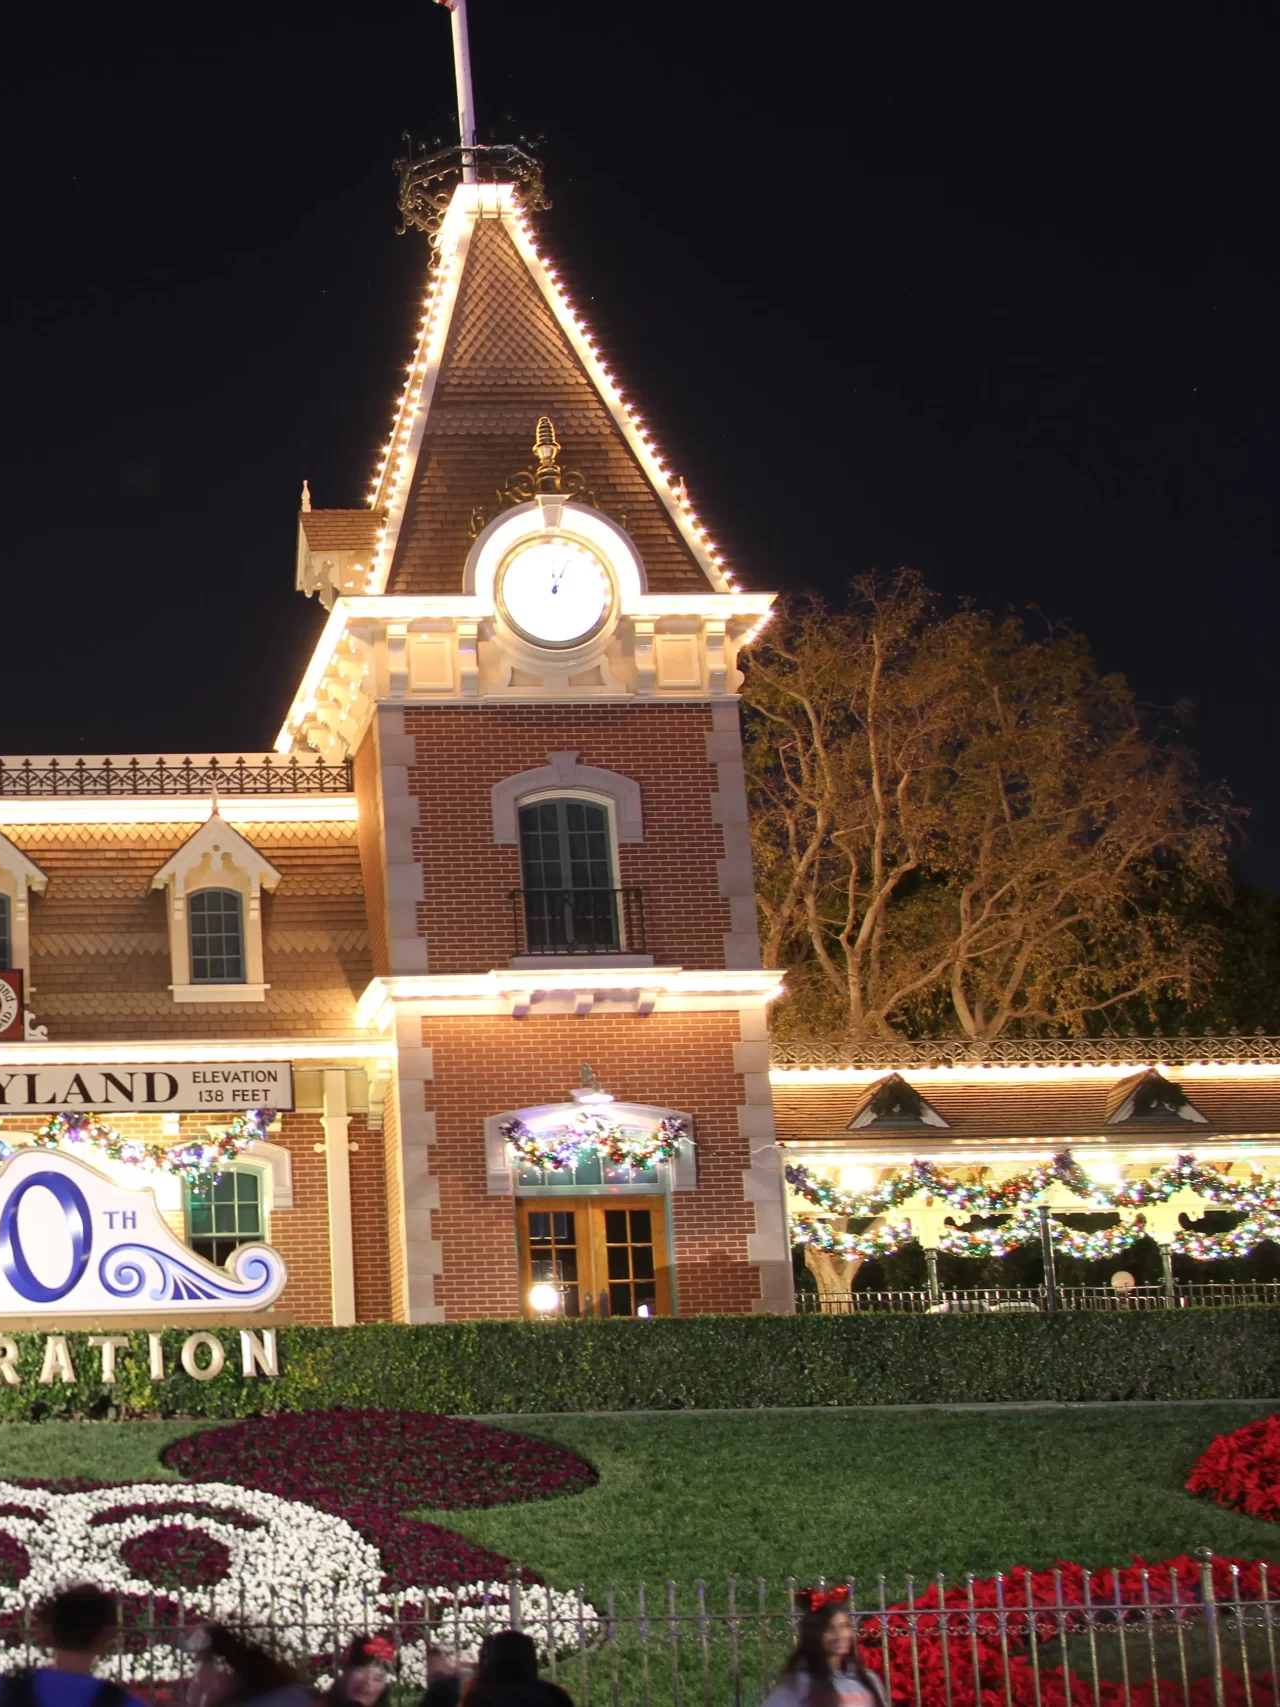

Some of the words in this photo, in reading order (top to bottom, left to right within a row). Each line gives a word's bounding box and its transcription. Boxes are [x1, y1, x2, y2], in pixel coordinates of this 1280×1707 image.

[192, 1070, 278, 1084] ELEVATION
[198, 1089, 225, 1103] 138
[232, 1089, 271, 1102] FEET
[103, 1210, 137, 1230] TH
